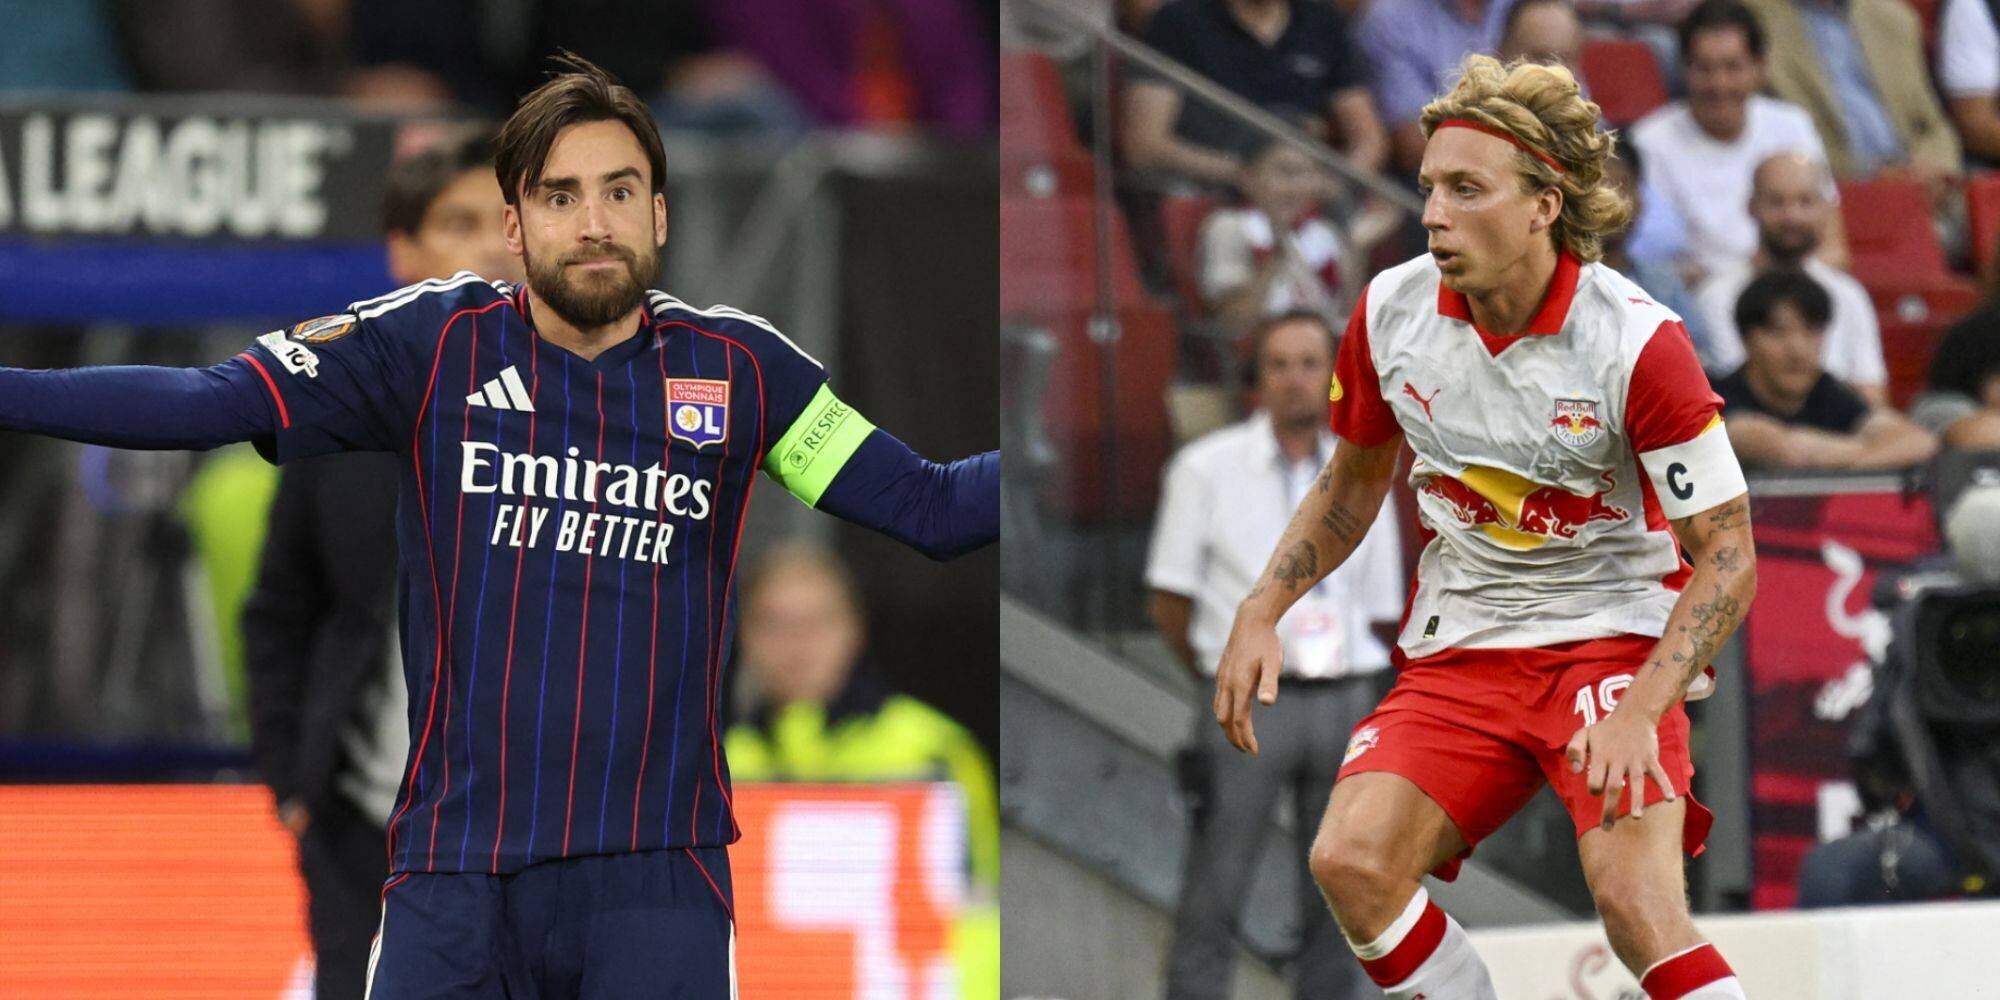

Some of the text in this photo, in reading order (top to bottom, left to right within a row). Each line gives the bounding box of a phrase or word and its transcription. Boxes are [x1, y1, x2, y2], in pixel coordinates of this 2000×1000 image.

[20, 114, 328, 238] LEAGUE
[673, 383, 724, 393] OLYMPIQUE
[674, 391, 723, 402] LYONNAIS
[461, 441, 712, 520] Emirates
[1666, 462, 1694, 501] C
[490, 504, 675, 565] FLY BETTER
